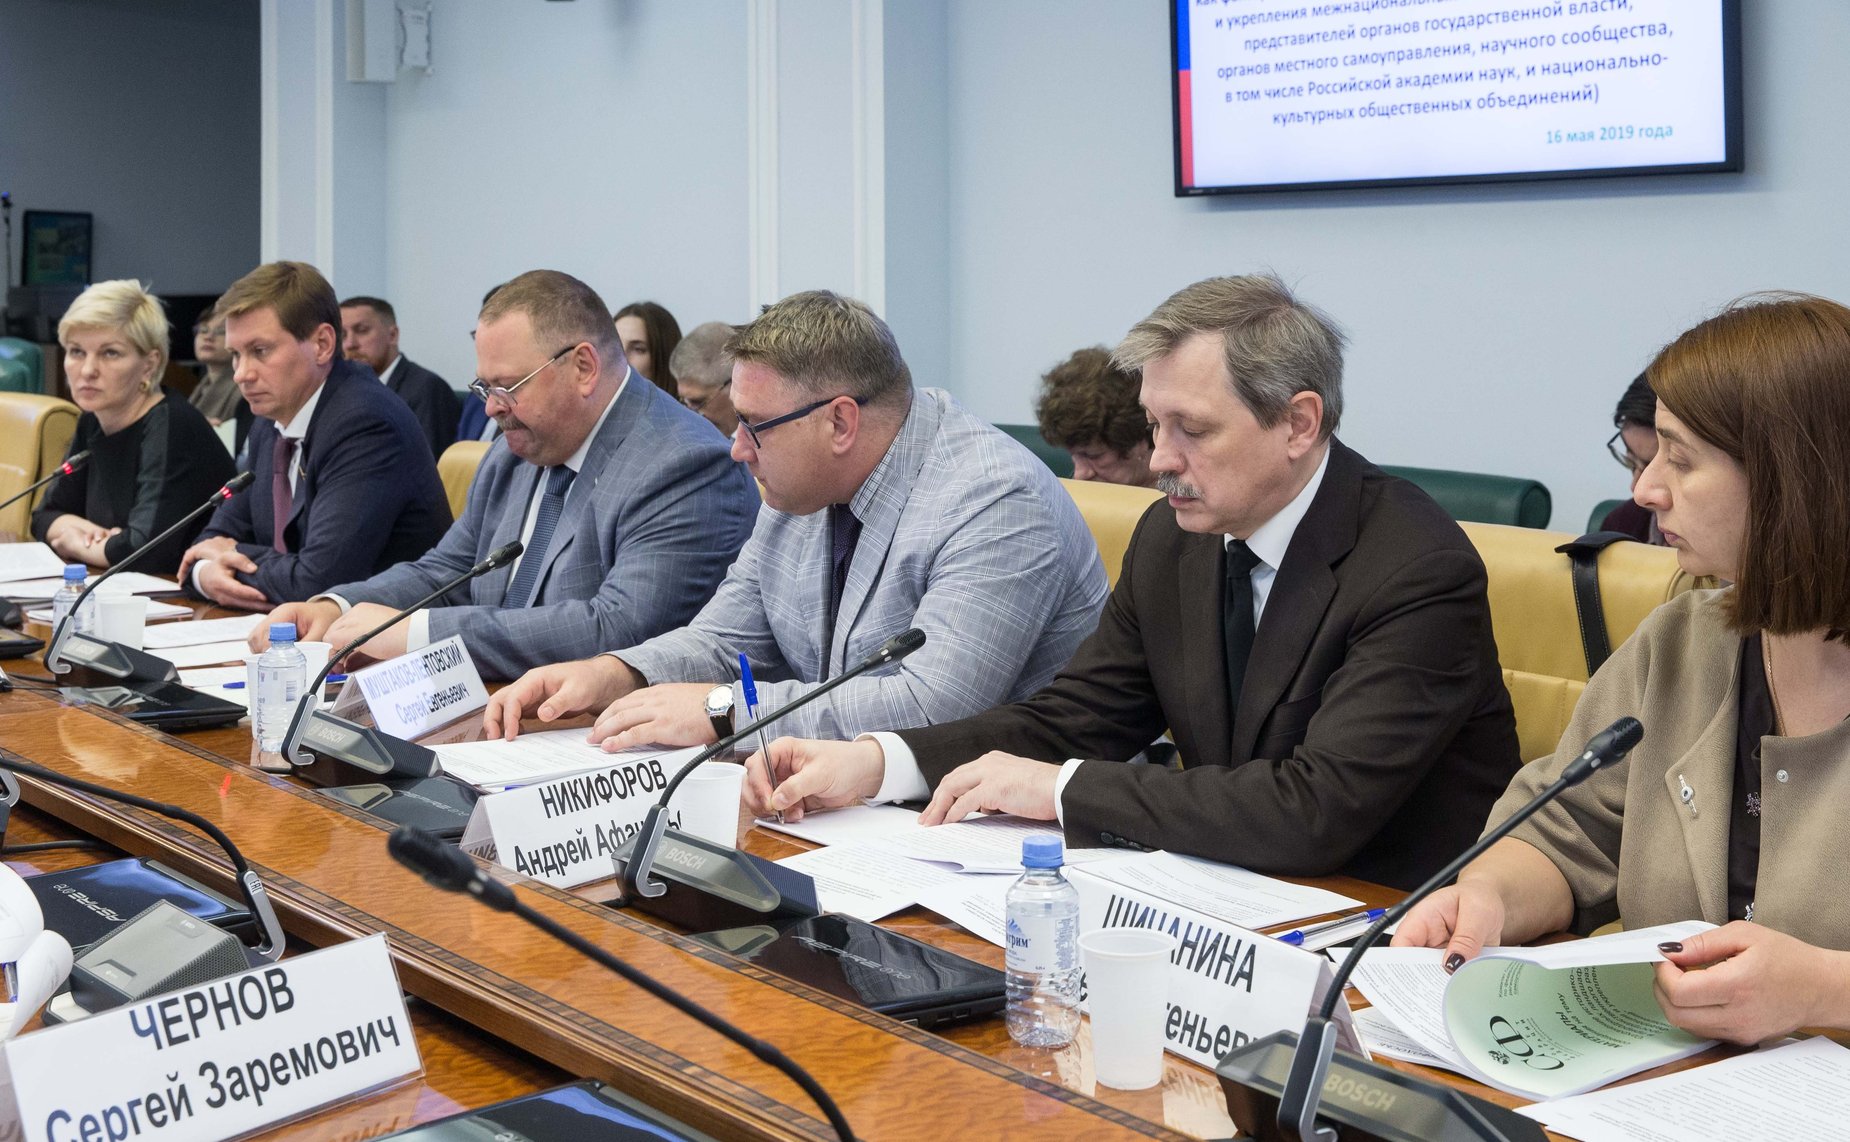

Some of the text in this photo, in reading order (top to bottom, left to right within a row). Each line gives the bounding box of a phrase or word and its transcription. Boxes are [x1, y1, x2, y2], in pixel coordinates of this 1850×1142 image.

[1215, 17, 1223, 29] и
[1228, 7, 1308, 30] укрепления
[1244, 0, 1634, 52] представителей органов государственной власти,
[1217, 21, 1674, 81] органов местного самоуправления, научного сообщества,
[1225, 52, 1668, 103] в том числе Российской академии наук, и национально-
[1273, 83, 1600, 128] культурных общественных объединений)
[1546, 124, 1674, 145] 16 мая 2019 года
[395, 682, 471, 726] Сергей Евгеньевич
[538, 759, 668, 819] НИКИФОРОВ
[514, 827, 593, 878] Андрей
[665, 846, 709, 871] BOSCH
[129, 967, 296, 1051] ЧЕРНОВ
[46, 1015, 402, 1142] Сергей Заремович
[1322, 1073, 1398, 1113] BOSCH
